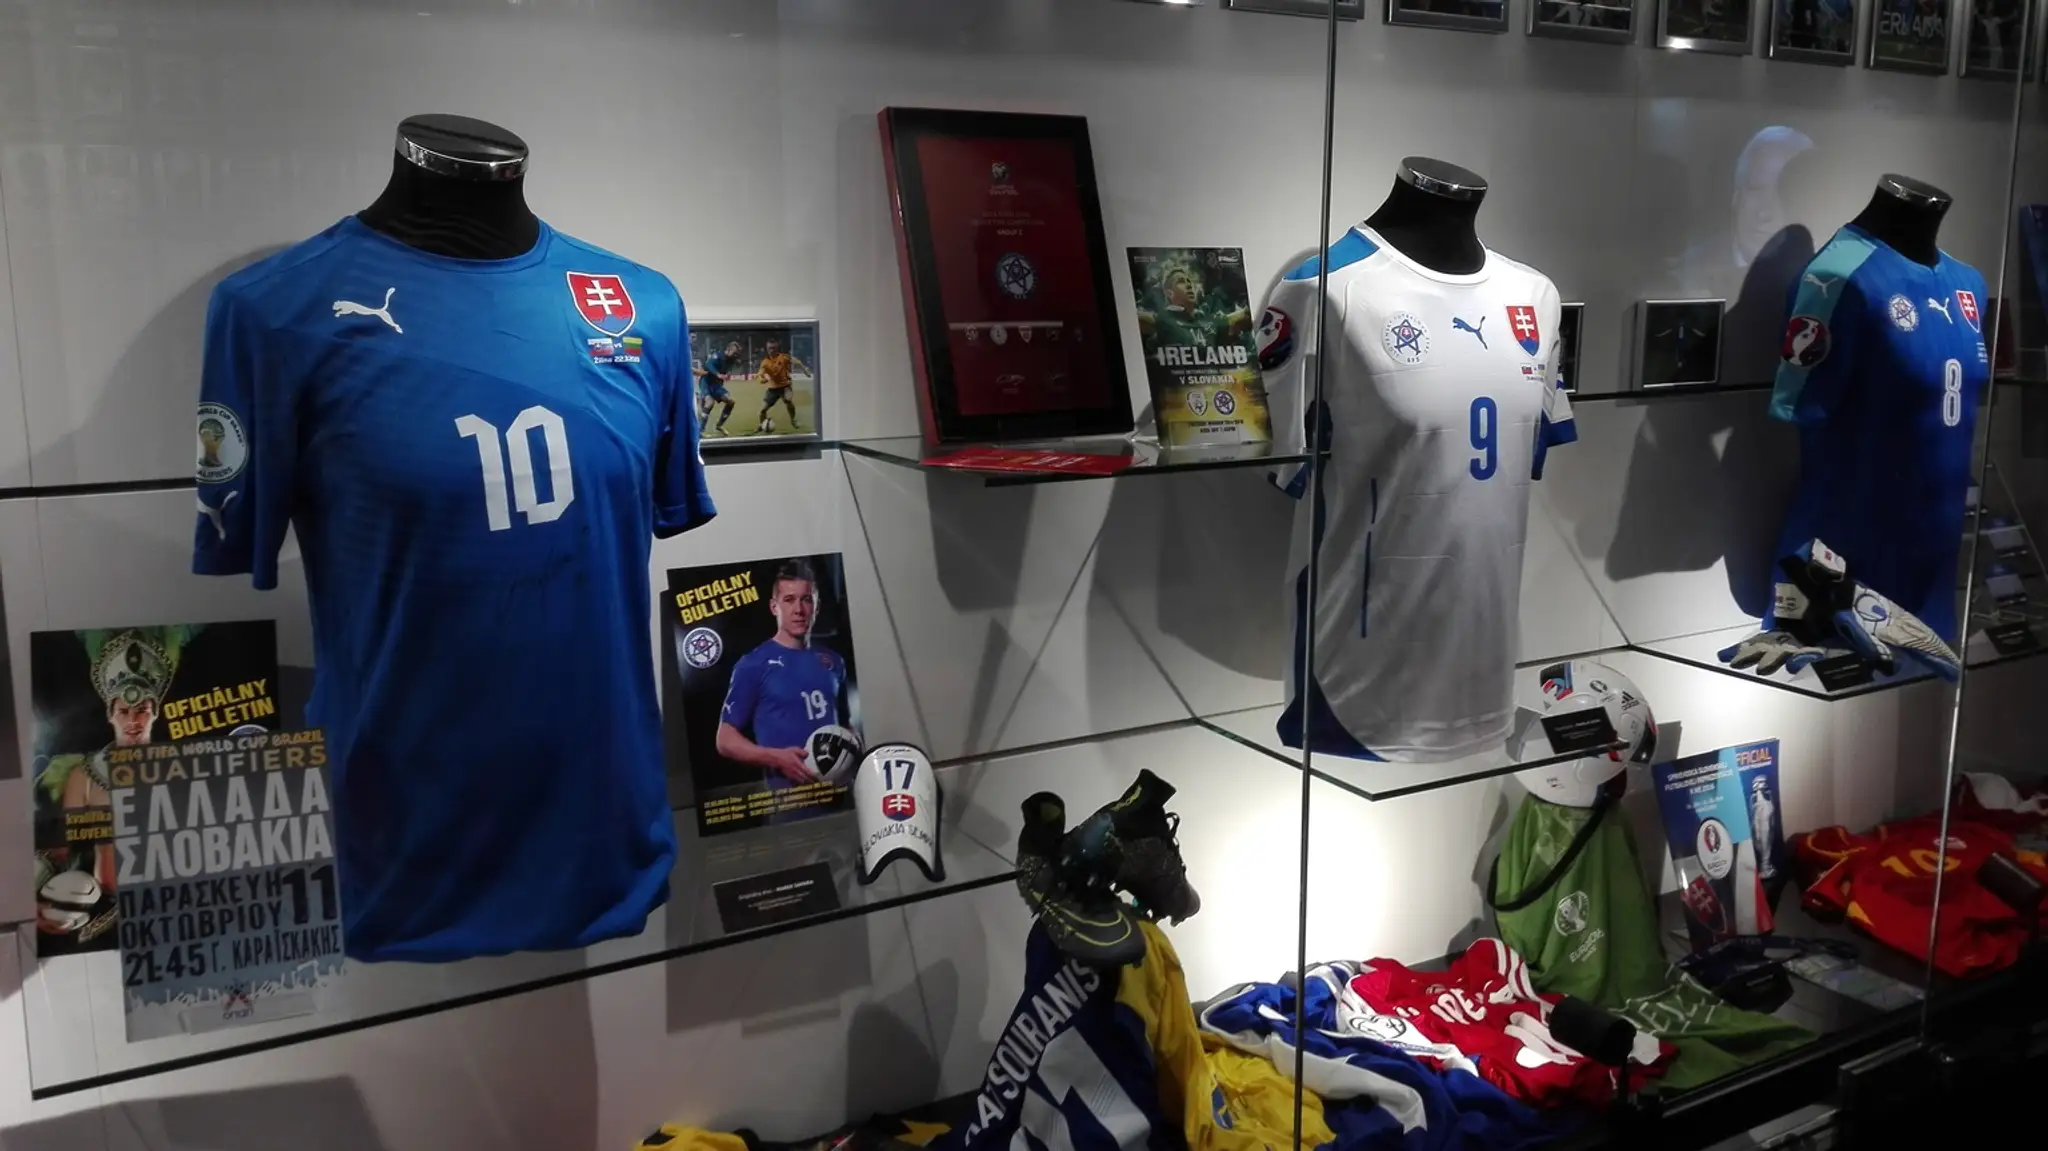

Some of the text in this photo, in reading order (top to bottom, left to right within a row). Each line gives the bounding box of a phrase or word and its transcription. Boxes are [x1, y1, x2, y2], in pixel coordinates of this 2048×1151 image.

[1156, 345, 1249, 366] IRELAND
[1187, 374, 1236, 386] SLOVAKIA
[1942, 358, 1962, 427] 8
[1469, 396, 1498, 481] 9
[454, 404, 575, 532] 10
[681, 586, 760, 625] BULLETIN
[168, 697, 275, 740] BULLETIN
[800, 689, 828, 721] 19
[109, 730, 325, 763] 2014 FIFA WORLD CUP BRAZIL
[111, 745, 327, 788] QUALIFIERS
[883, 759, 916, 791] 17
[111, 767, 330, 837] ΕΛΛΑΔΑ
[114, 813, 334, 887] ΣΛΟΒΑΚΙΑ
[118, 864, 339, 926] ΠΑΡΑΣΚΕΥΗ 11
[121, 900, 283, 950] ΟΚΤΩΒΡΙΟΥ
